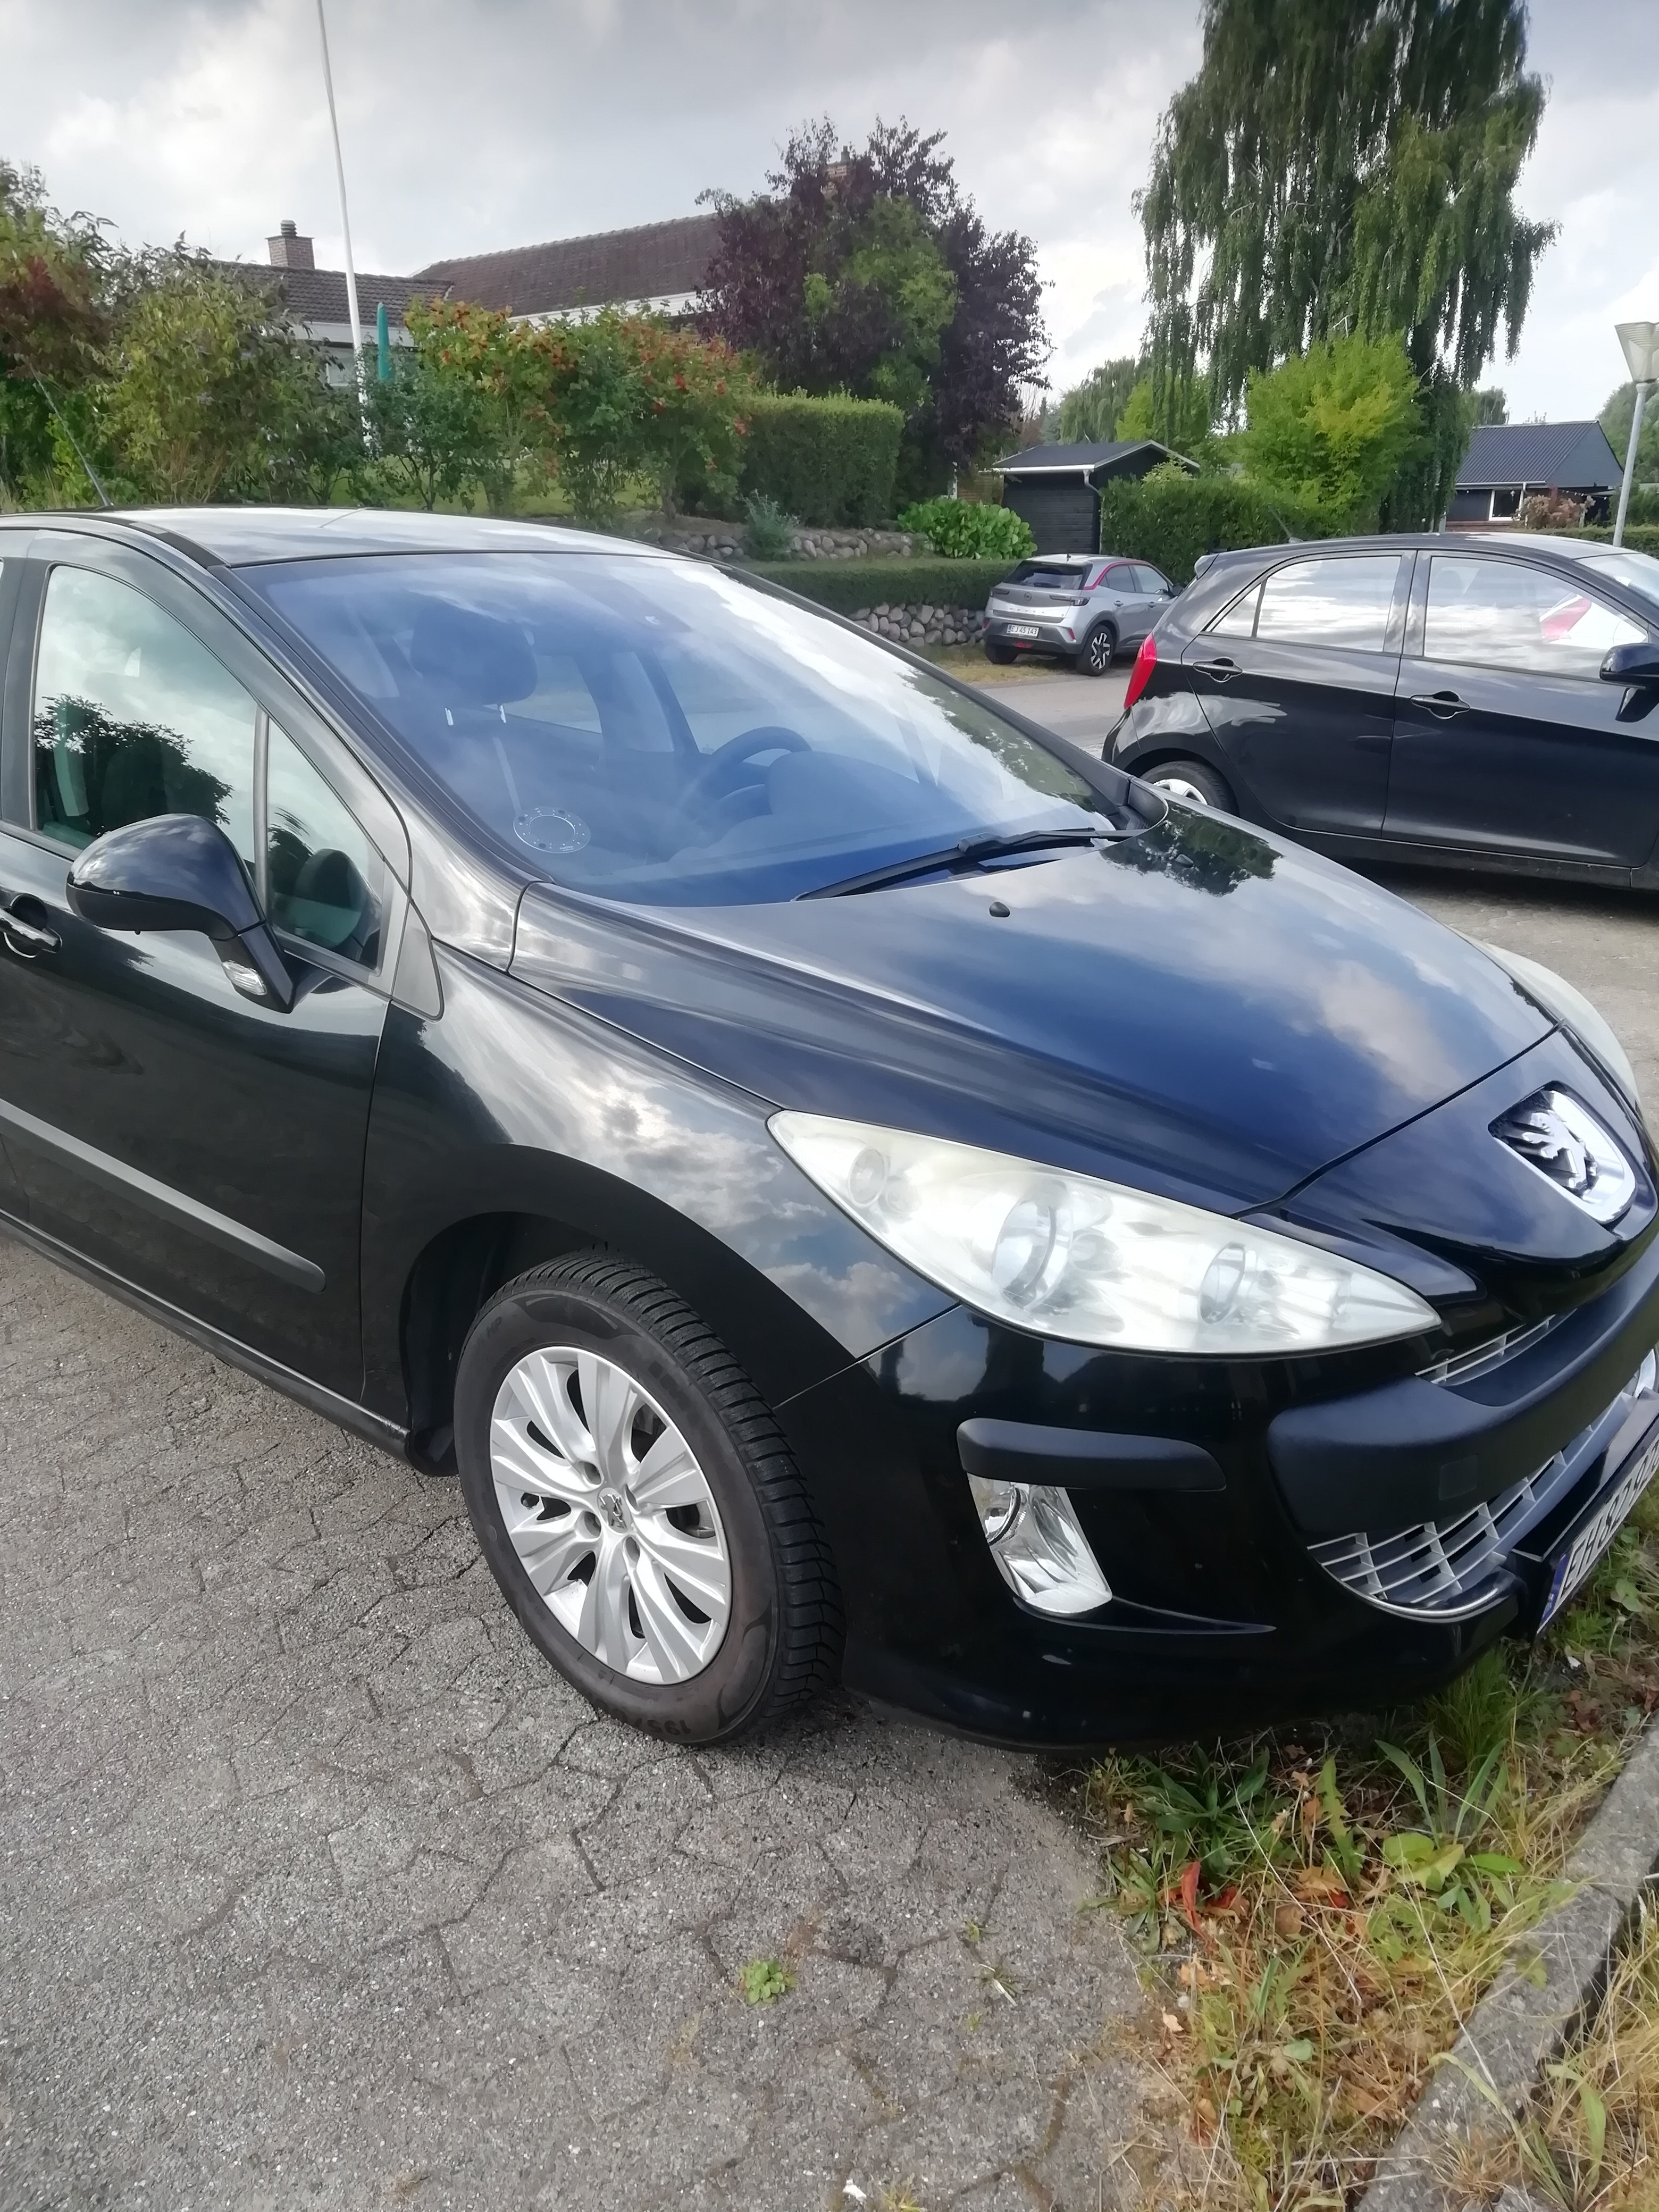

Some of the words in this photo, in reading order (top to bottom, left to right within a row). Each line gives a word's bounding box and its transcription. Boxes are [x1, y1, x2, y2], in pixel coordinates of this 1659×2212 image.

[1560, 1514, 1604, 1599] EH
[1597, 1478, 1632, 1549] 82
[1629, 1439, 1659, 1507] 92
